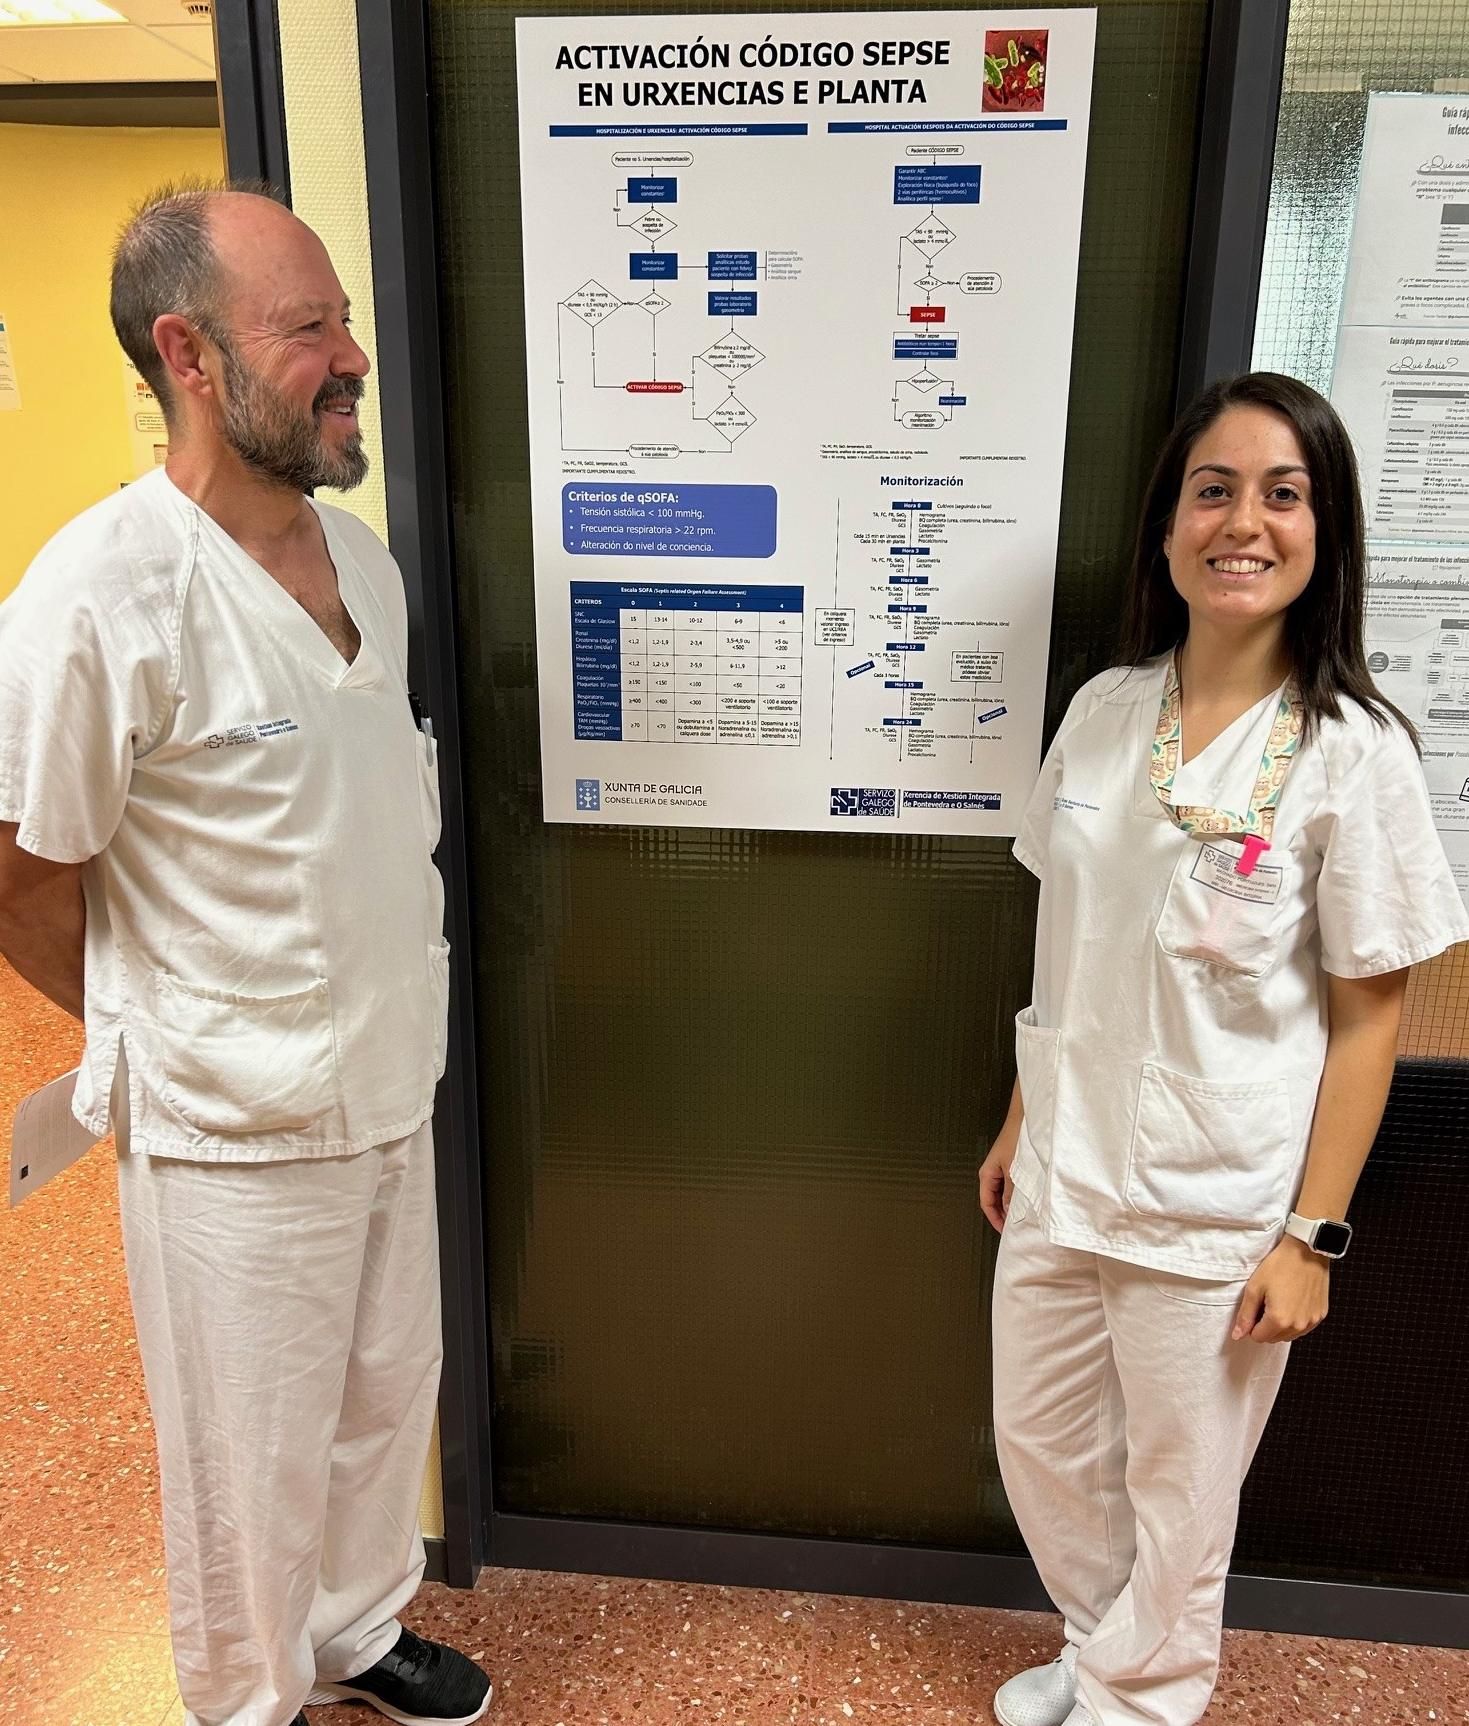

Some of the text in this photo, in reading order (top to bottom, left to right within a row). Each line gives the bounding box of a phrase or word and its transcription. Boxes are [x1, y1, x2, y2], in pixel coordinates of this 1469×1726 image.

[555, 35, 950, 69] ACTIVACIÓN CÓDIGO SEPSE
[579, 79, 926, 106] EN URXENCIAS E PLANTA
[1442, 107, 1457, 118] Guía
[881, 476, 963, 486] Monitorización
[569, 491, 678, 504] Criterios de qSOFA:
[580, 507, 611, 516] Tensión
[614, 508, 645, 516] sistólica
[658, 509, 672, 517] 100
[675, 509, 704, 520] mmHg.
[581, 524, 623, 533] Frecuencia
[627, 525, 672, 535] respiratoria
[684, 526, 694, 534] 22
[697, 528, 715, 536] rpm.
[581, 540, 714, 551] Alteración do nivel de conciencia.
[228, 730, 255, 741] GALEGO
[605, 783, 701, 794] XUNTA DE GALICIA
[864, 790, 895, 798] SERVIZO
[903, 791, 932, 799] Xerencia
[968, 793, 1000, 801] Integrada
[862, 799, 895, 807] GALEGO
[859, 807, 894, 816] de SAÚDE
